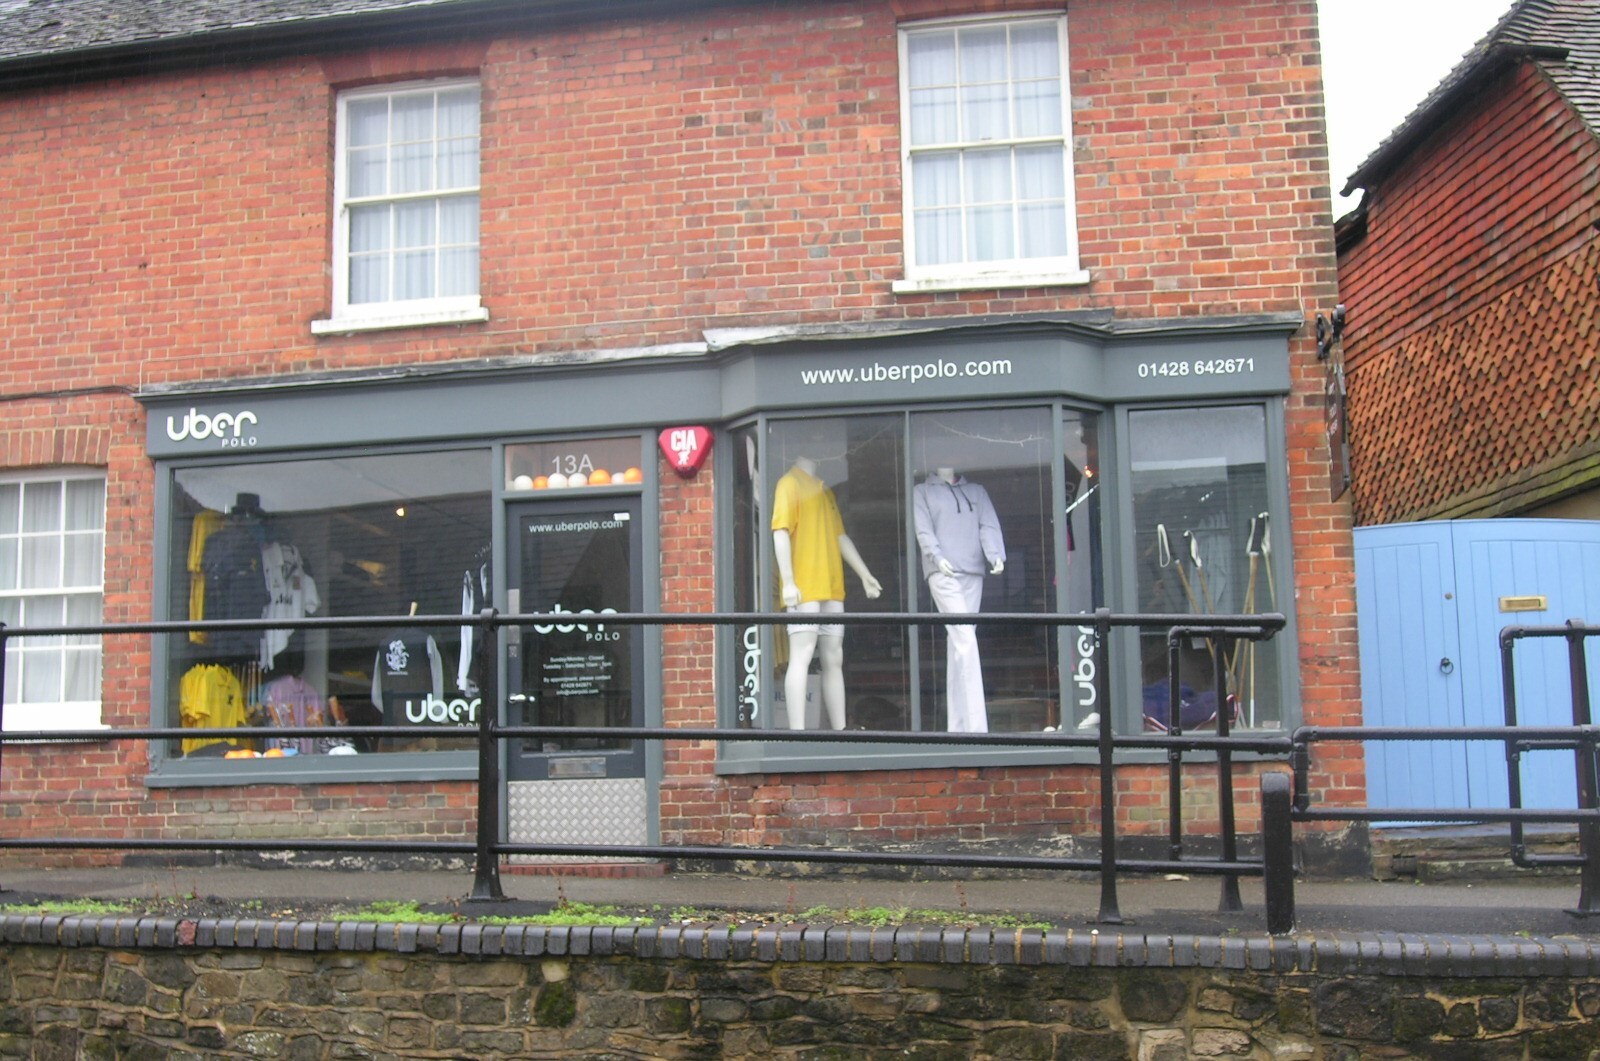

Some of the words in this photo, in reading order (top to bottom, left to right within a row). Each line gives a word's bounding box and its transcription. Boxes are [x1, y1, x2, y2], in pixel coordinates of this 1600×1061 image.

[801, 359, 1012, 384] www.uberpolo.com
[1138, 361, 1190, 378] 01428
[1194, 358, 1254, 375] 642671
[166, 407, 258, 441] uber
[221, 436, 258, 448] POLO
[670, 429, 698, 452] CIA
[551, 453, 594, 475] 13A
[529, 520, 623, 533] www.uberpolo.com
[585, 632, 620, 642] POLO
